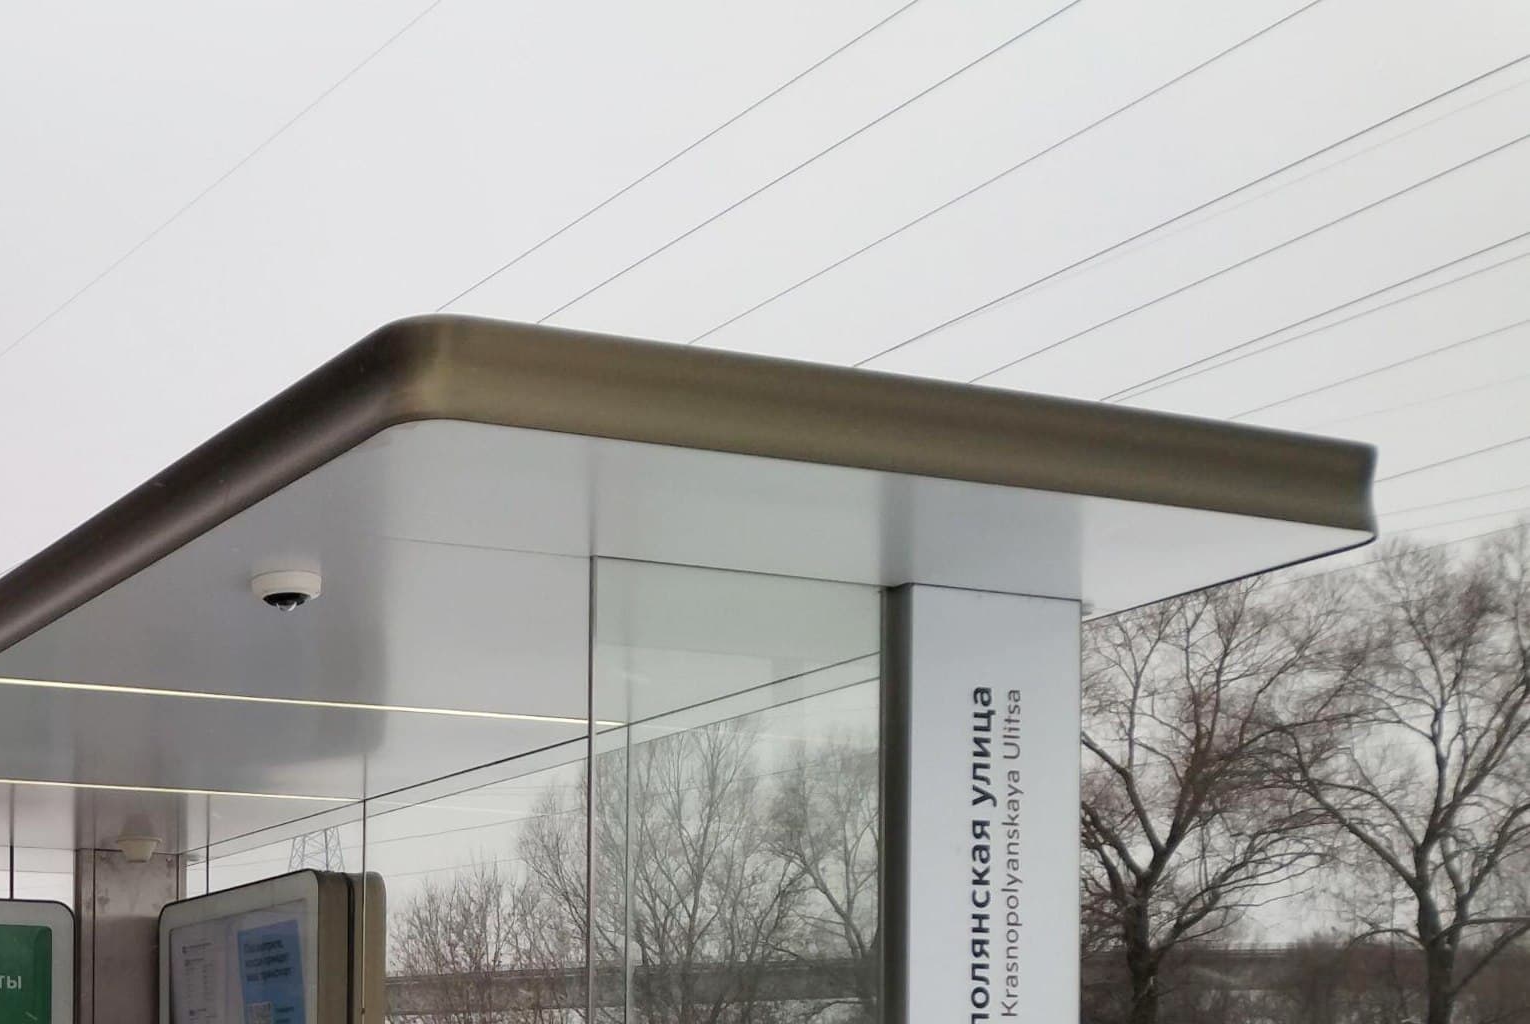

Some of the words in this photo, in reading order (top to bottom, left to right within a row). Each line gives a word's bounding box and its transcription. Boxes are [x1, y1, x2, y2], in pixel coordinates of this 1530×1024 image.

[972, 686, 997, 807] улица
[1003, 688, 1021, 760] Ulitsa
[1001, 770, 1023, 1018] Krasnopolyanskaya
